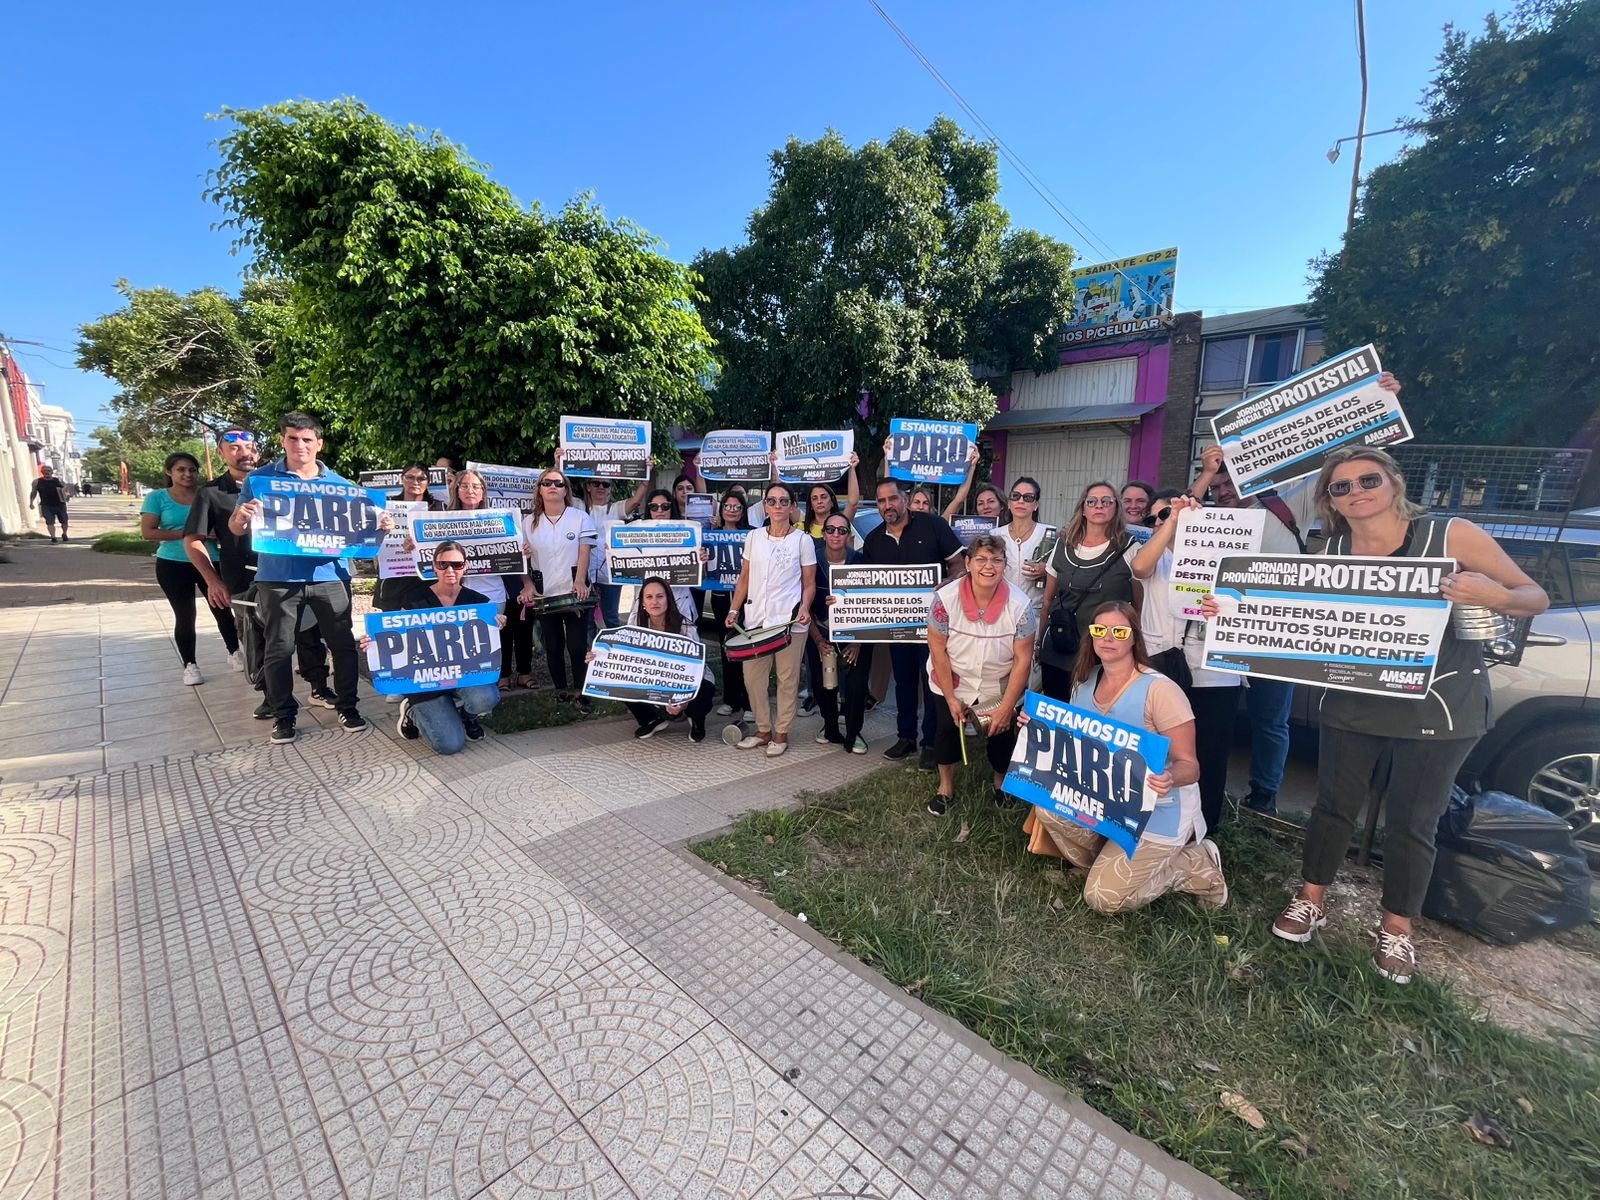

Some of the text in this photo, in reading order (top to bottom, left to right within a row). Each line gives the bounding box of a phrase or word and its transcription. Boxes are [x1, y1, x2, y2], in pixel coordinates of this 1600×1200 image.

[1085, 262, 1119, 276] SANTA
[1123, 260, 1136, 268] FE
[1146, 252, 1161, 263] CP
[1060, 318, 1160, 343] IOS P/CELULAR
[1270, 355, 1370, 412] PROTESTA!
[1236, 398, 1272, 420] JORNADA
[900, 422, 964, 434] ESTAMOS DE
[1220, 406, 1274, 435] PROVINCIAL DE
[1240, 396, 1361, 450] EN DEFENSA DE LOS
[1232, 400, 1385, 465] INSTITUTOS SUPERIORES
[1364, 423, 1401, 445] AMSAFE
[782, 434, 800, 449] NO!
[784, 440, 838, 456] PRESENTISMO
[893, 432, 968, 463] PARO
[1236, 464, 1252, 476] DE
[1254, 437, 1325, 471] FORMACIÓN
[1326, 411, 1390, 442] DOCENTE
[566, 450, 646, 461] ¡SALARIOS DIGNOS!
[703, 455, 767, 468] ¡SALARIOS DIGNOS!
[596, 464, 622, 472] AMSAFE
[727, 468, 748, 476] AMSAFE
[803, 470, 826, 478] AMSAFE
[910, 464, 944, 476] AMSAFE
[492, 476, 520, 484] DOCENTES
[270, 480, 368, 498] ESTAMOS DE
[263, 492, 378, 532] PARO
[1205, 512, 1234, 521] SI LA
[438, 522, 468, 530] DOCENTES
[474, 526, 505, 534] EDUCATIVA
[1185, 525, 1253, 536] EDUCACIÓN
[296, 534, 346, 548] AMSAFE
[703, 532, 747, 542] ESTAMOS
[1201, 540, 1214, 548] LA
[1218, 541, 1250, 550] BASE
[476, 541, 519, 557] DIGNOS!
[466, 560, 492, 570] MSAFE
[612, 558, 626, 569] ¡EN
[627, 557, 656, 568] DEFENSA
[657, 558, 670, 567] DEL
[1177, 558, 1206, 567] ¿POR
[1248, 562, 1298, 574] JORNADA
[834, 578, 872, 586] PROVINCIAL DE
[872, 570, 934, 586] PROTESTA!
[1222, 572, 1298, 586] PROVINCIAL DE
[1298, 563, 1442, 594] PROTESTA!
[382, 608, 478, 628] ESTAMOS DE
[882, 606, 928, 614] SUPERIORE
[1238, 604, 1406, 627] EN DEFENSA DE LOS
[834, 616, 845, 624] DE
[846, 615, 894, 624] FORMACIÓN
[1216, 616, 1430, 646] INSTITUTOS SUPERIORES
[375, 618, 492, 670] PARO
[640, 632, 700, 656] PROTESTA!
[1215, 630, 1426, 664] DE FORMACIÓN DOCENTE
[608, 652, 686, 672] EN DEFENSA DE LOS
[414, 664, 462, 684] AMSAFE
[592, 670, 604, 678] DE
[604, 672, 654, 685] FORMACIÓN
[594, 660, 695, 682] INSTITUTOS SUPERIORES
[1379, 670, 1426, 685] AMSAFE
[1036, 701, 1141, 752] ESTAMOS DE
[1026, 719, 1149, 808] PARO
[1050, 782, 1105, 822] AMSAFE
